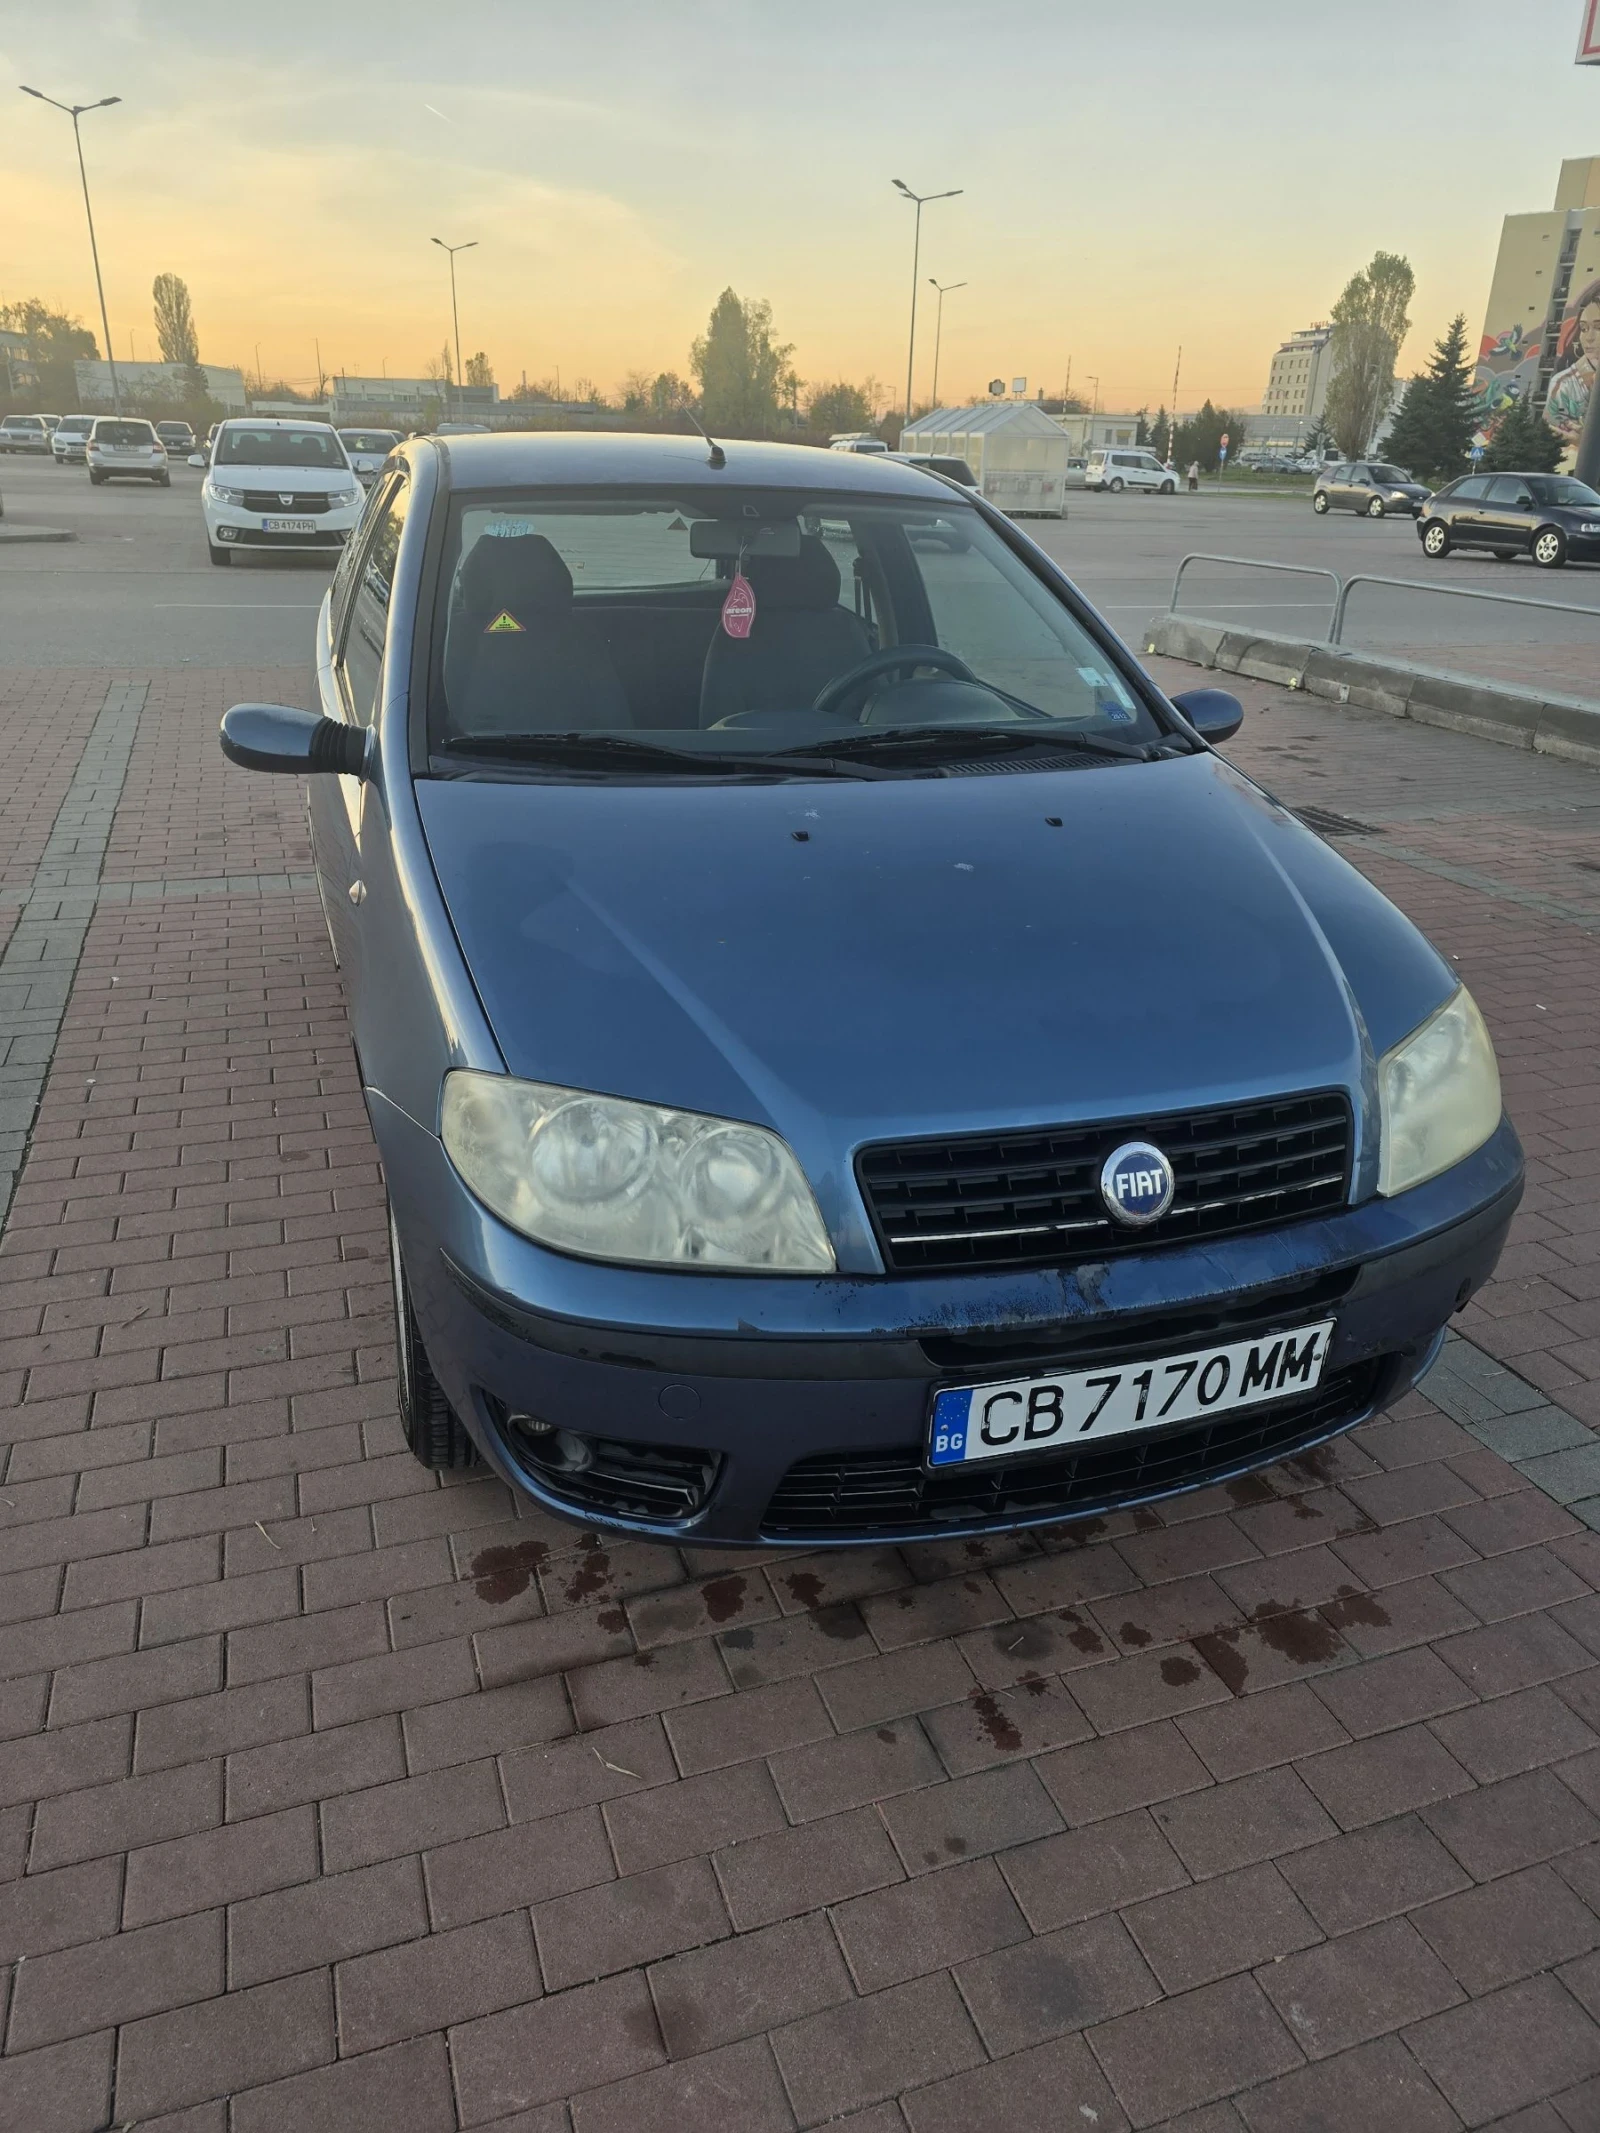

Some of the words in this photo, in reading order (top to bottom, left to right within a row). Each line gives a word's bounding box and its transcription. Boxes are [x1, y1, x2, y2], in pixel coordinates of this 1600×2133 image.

[725, 607, 753, 615] areon
[1116, 1169, 1163, 1199] FIAT
[981, 1384, 1064, 1446] CB
[1079, 1354, 1231, 1432] 7170
[1238, 1331, 1321, 1398] MM
[935, 1433, 963, 1453] BG
